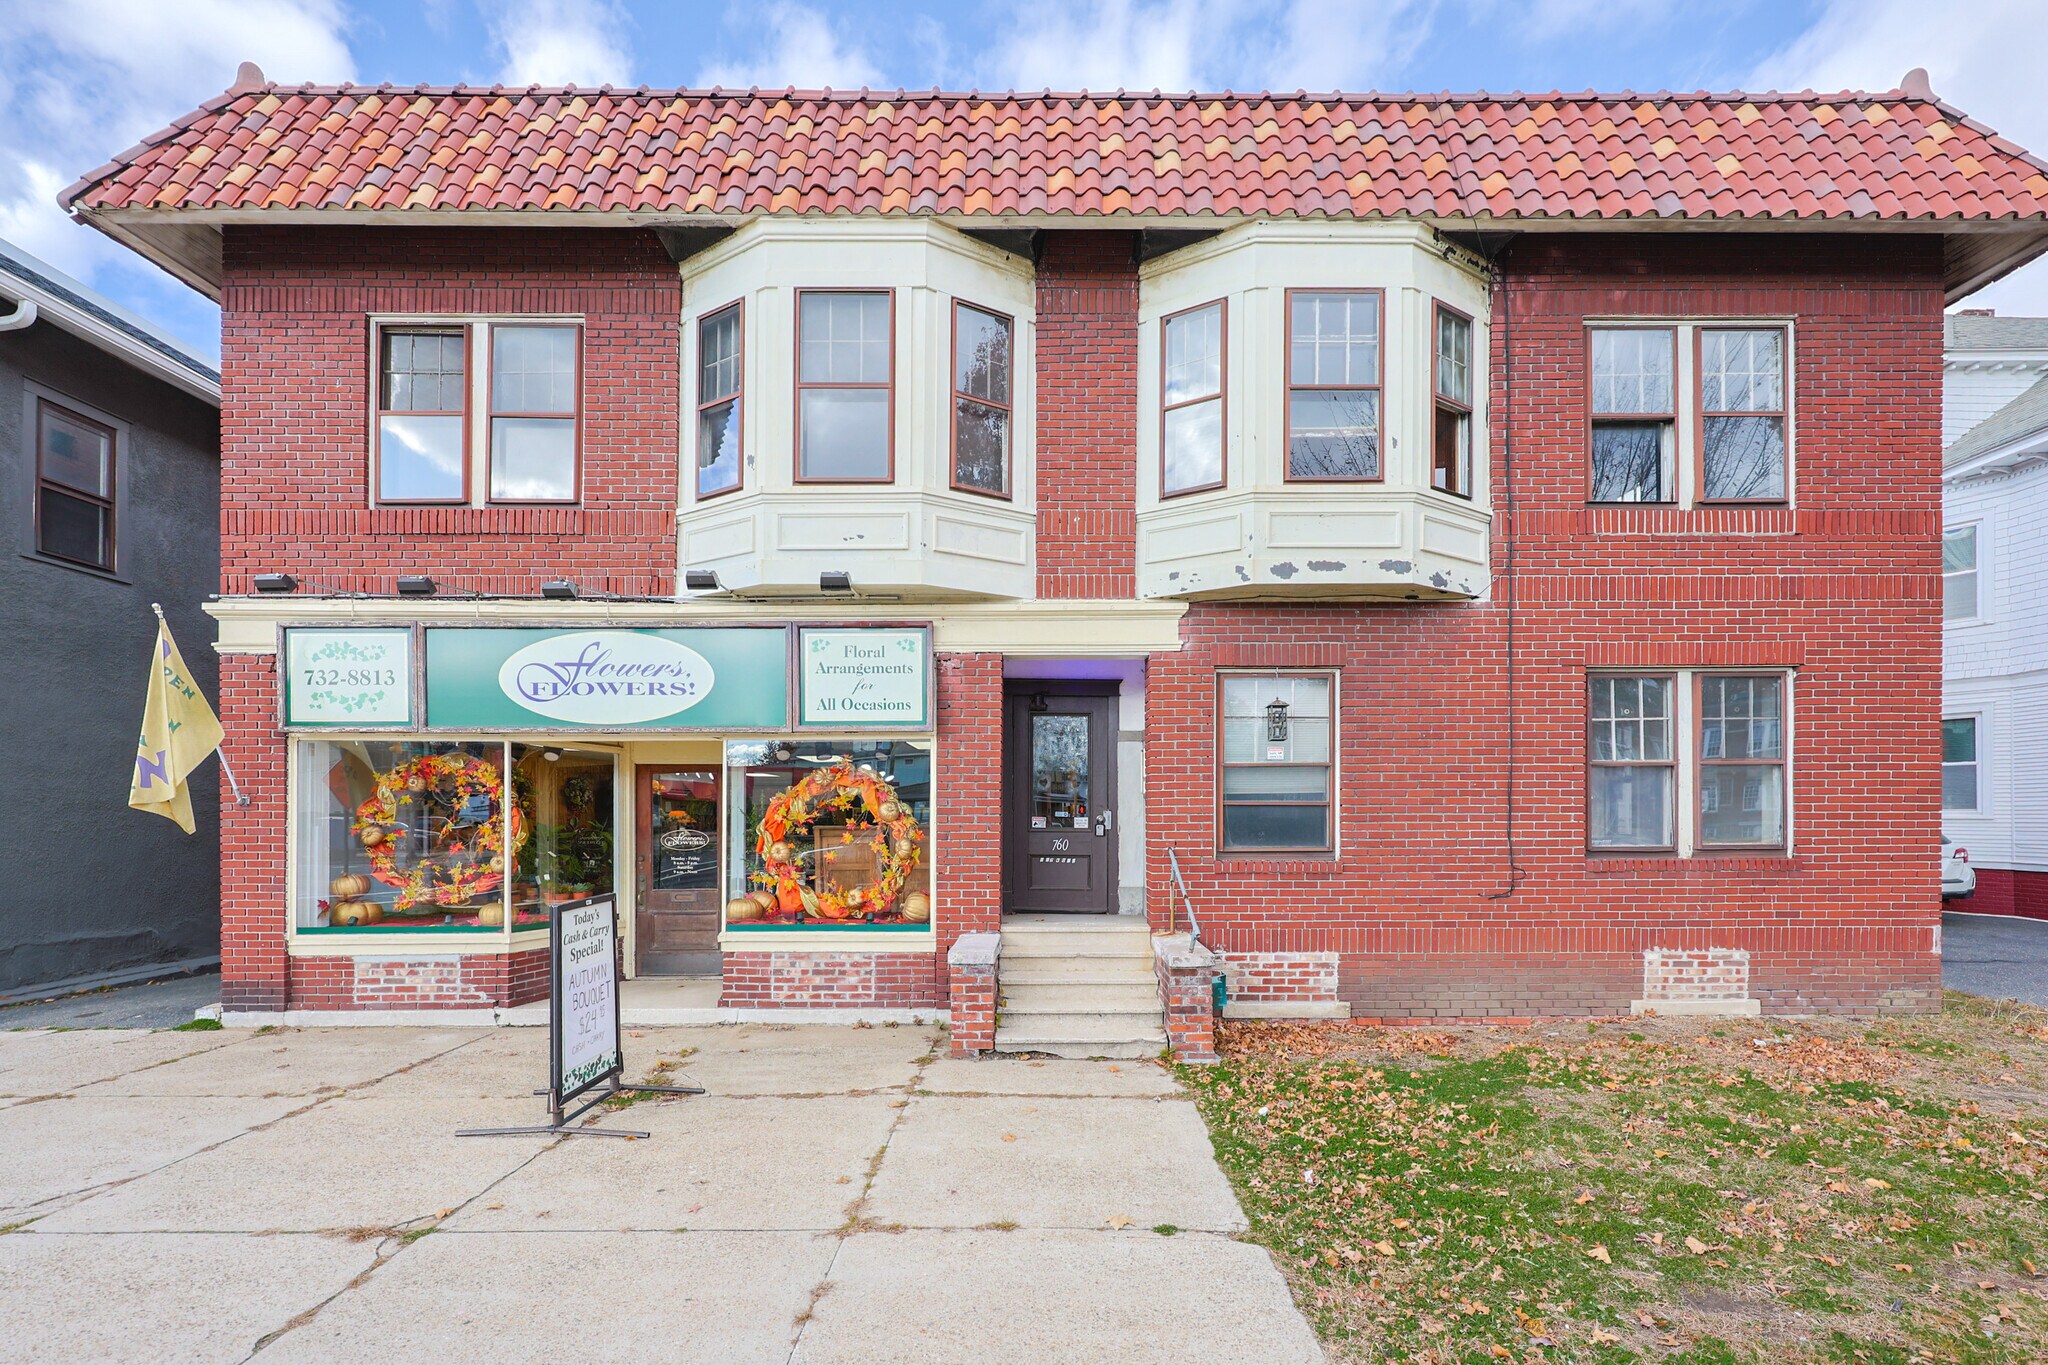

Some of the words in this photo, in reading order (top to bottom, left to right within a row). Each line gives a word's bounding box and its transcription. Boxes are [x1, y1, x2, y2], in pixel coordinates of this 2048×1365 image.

[844, 645, 885, 658] Floral
[304, 669, 396, 686] 732-8813
[815, 662, 914, 676] Arrangements
[530, 681, 696, 696] FLOWERS!
[852, 678, 875, 695] for
[816, 698, 836, 711] All
[841, 697, 912, 711] Occasions
[1052, 838, 1069, 851] 760
[573, 908, 600, 926] Today's
[563, 929, 580, 946] Cash
[582, 929, 588, 941] &
[589, 925, 610, 938] Carry
[570, 938, 604, 964] Special!
[569, 963, 607, 991] AUTUMN
[573, 980, 611, 1011] BOUQUET
